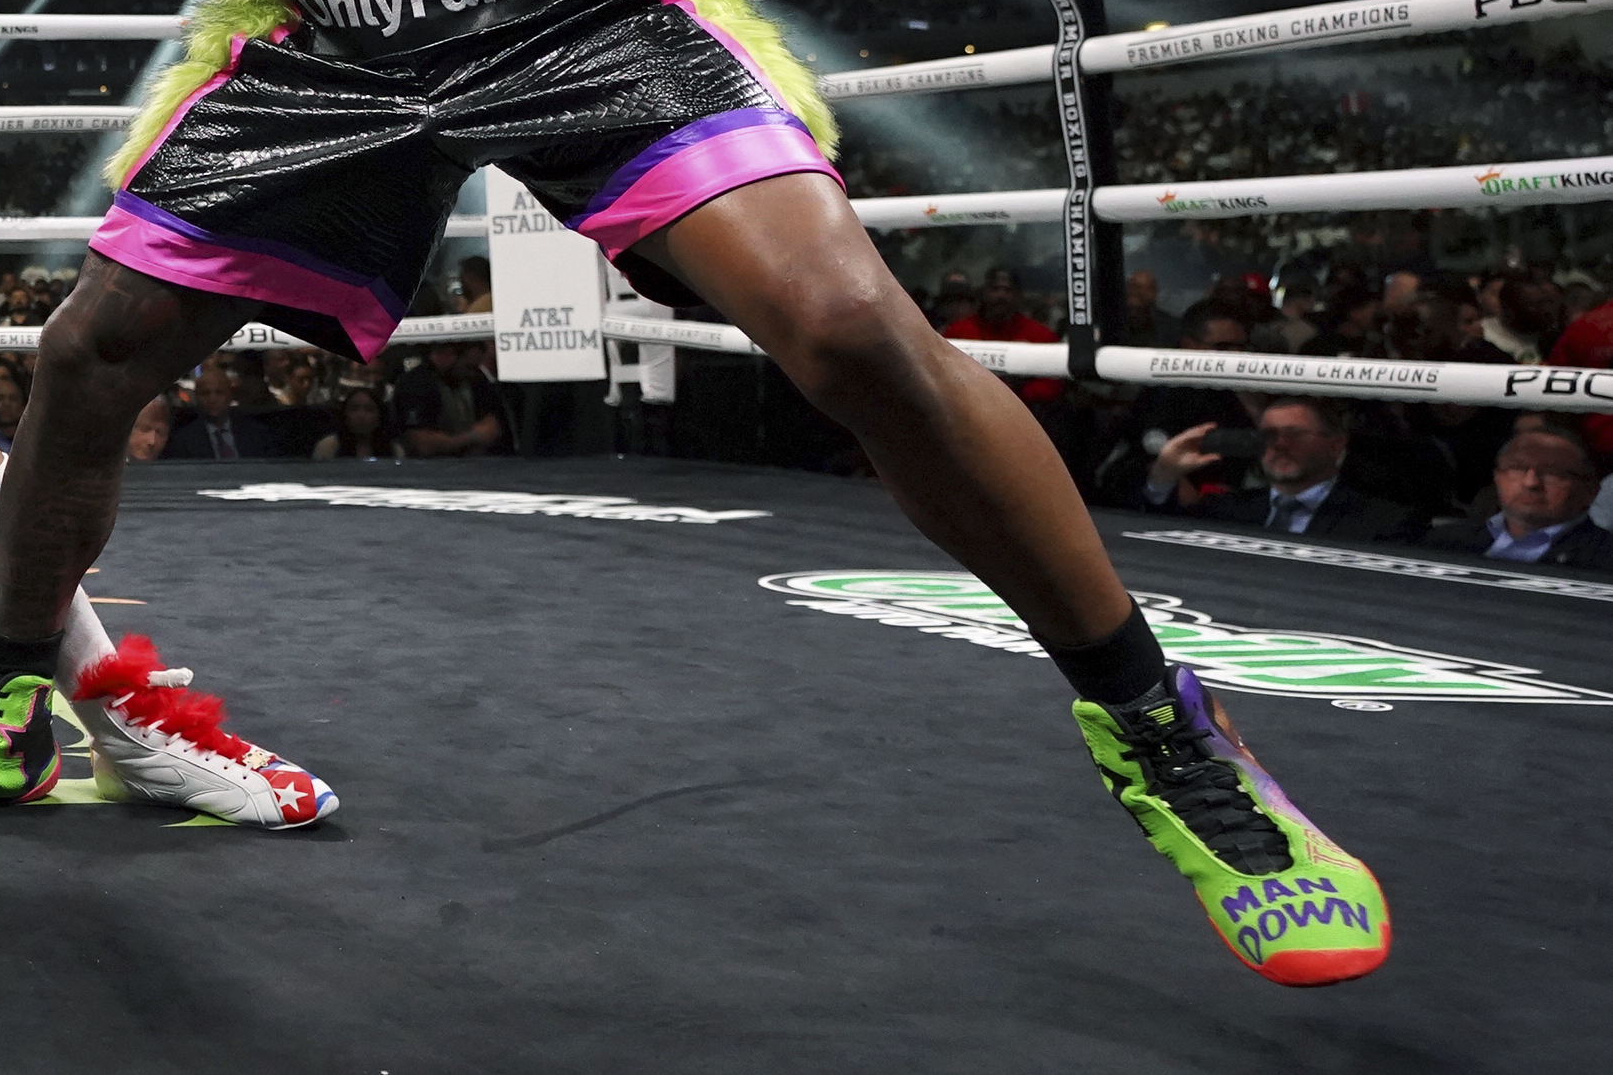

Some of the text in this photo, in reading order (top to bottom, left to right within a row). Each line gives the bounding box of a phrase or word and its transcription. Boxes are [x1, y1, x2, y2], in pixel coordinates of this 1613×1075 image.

[1127, 4, 1409, 65] PREMIER BOXING CHAMPIONS
[1063, 92, 1087, 179] BOXING
[1481, 171, 1613, 196] DRAFTKING
[514, 192, 537, 210] AT
[493, 214, 568, 234] STADI
[1070, 189, 1087, 325] CHAMPIONS
[520, 307, 574, 328] AT&T
[499, 329, 600, 352] STADIUM
[1150, 357, 1439, 384] PREMIER BOXING CHAMPIONS
[1221, 877, 1339, 923] MAN
[1238, 897, 1370, 965] DOWN
